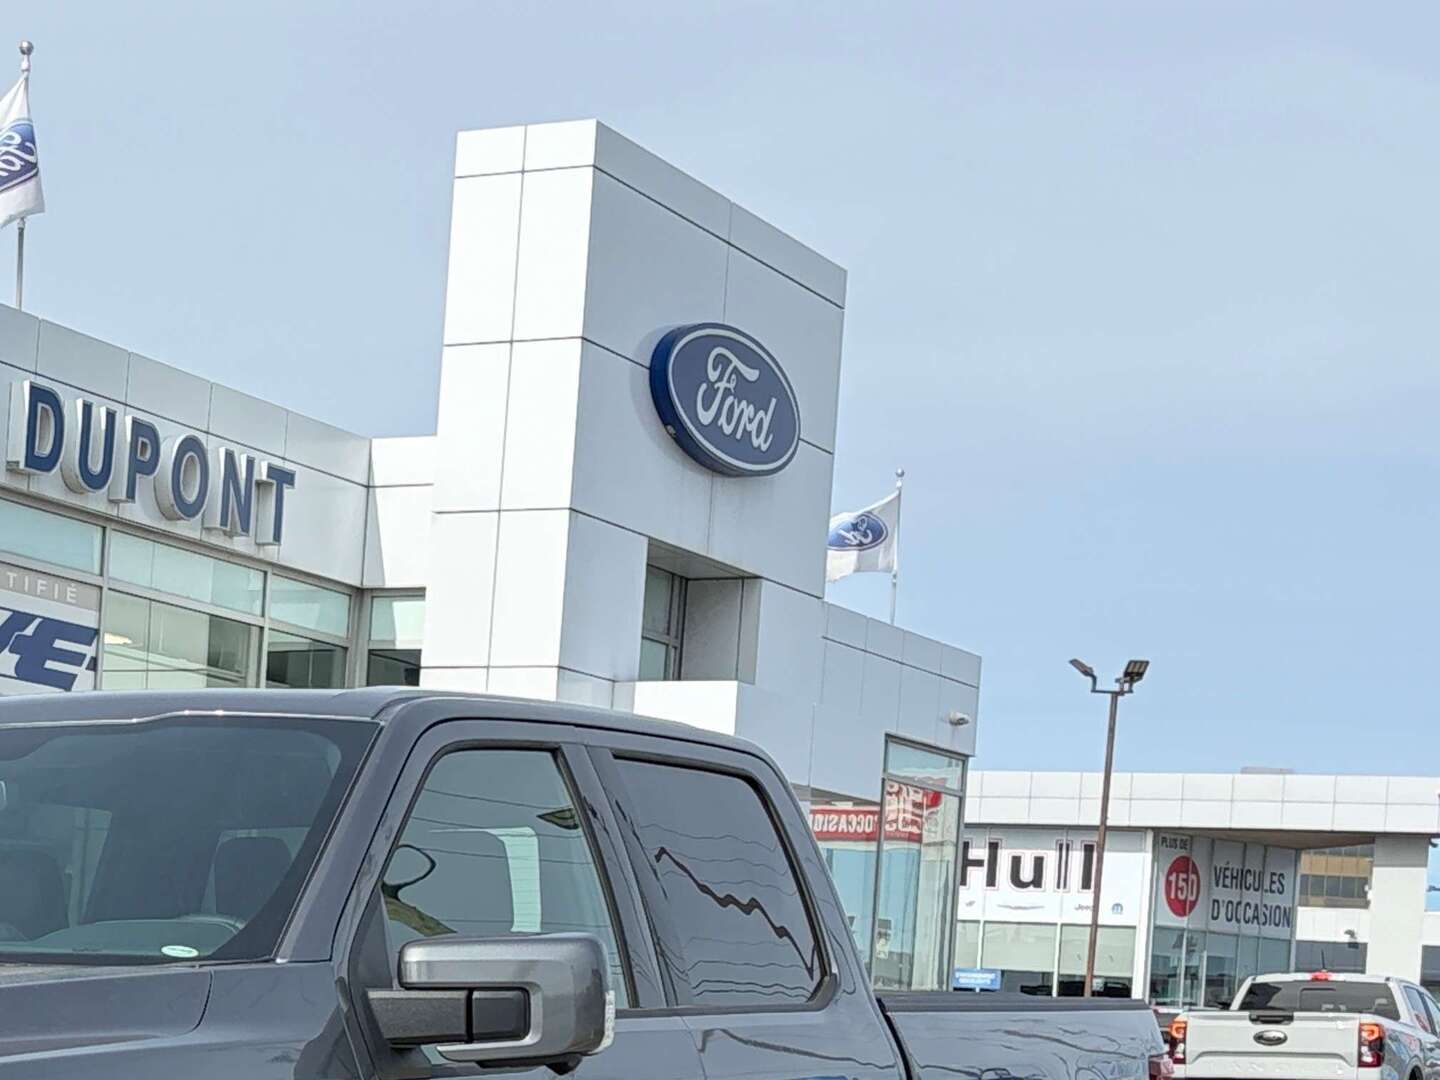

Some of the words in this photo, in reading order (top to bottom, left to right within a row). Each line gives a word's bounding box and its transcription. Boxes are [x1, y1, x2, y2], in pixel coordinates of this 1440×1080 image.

[696, 346, 777, 452] Ford
[8, 380, 297, 546] DUPONT
[960, 841, 1095, 889] Hull
[1213, 861, 1286, 895] VÉHICULES
[1168, 872, 1197, 901] 150
[1211, 899, 1291, 928] D'OCCASION
